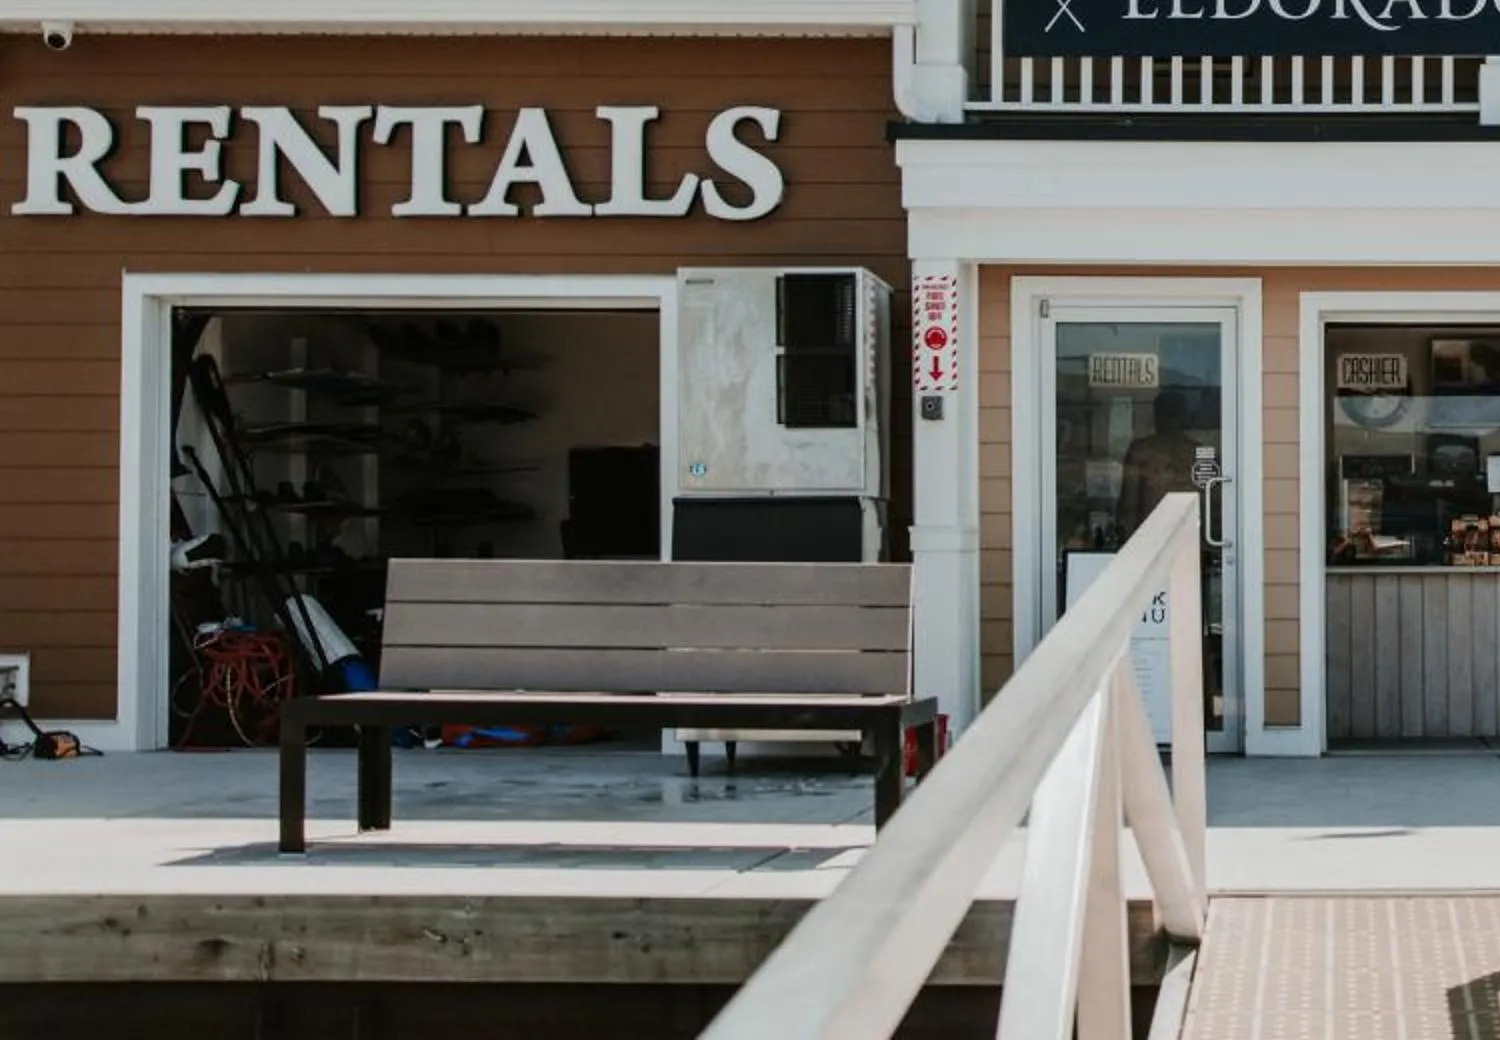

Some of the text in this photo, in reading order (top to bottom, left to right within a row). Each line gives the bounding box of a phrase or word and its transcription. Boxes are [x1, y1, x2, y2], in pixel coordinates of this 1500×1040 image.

[13, 106, 783, 220] RENTALS
[1093, 356, 1156, 385] RENTALS
[1343, 357, 1401, 385] CASHIER
